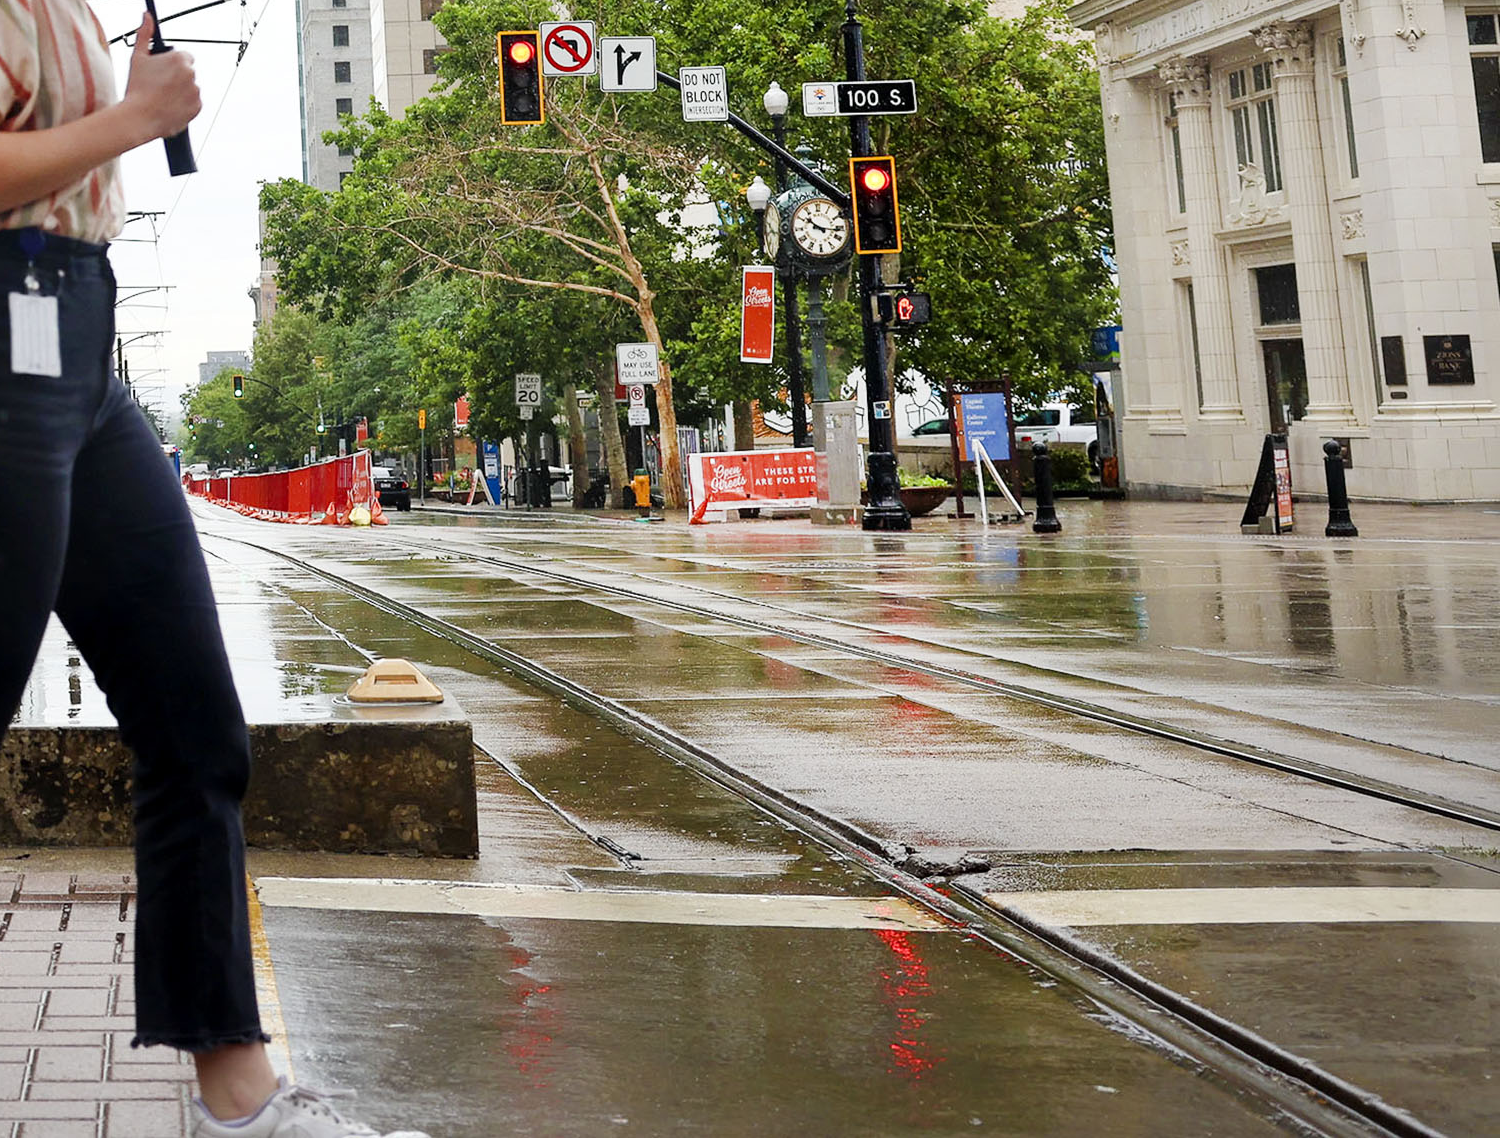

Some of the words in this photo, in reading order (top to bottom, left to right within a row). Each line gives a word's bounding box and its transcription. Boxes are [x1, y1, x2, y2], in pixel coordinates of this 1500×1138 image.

[1171, 5, 1204, 39] FIRST
[684, 74, 698, 86] DO
[702, 73, 720, 85] NOT
[686, 90, 722, 103] BLOCK
[847, 90, 879, 107] 100
[890, 89, 906, 106] S.
[748, 286, 768, 297] Open
[745, 295, 771, 307] Streets
[1438, 362, 1461, 371] BANK
[639, 370, 656, 378] LANE
[518, 390, 539, 402] 20
[713, 464, 743, 479] Open
[764, 467, 794, 476] THESE
[710, 476, 747, 493] Streets
[755, 478, 773, 486] ARE
[777, 477, 796, 485] FOR
